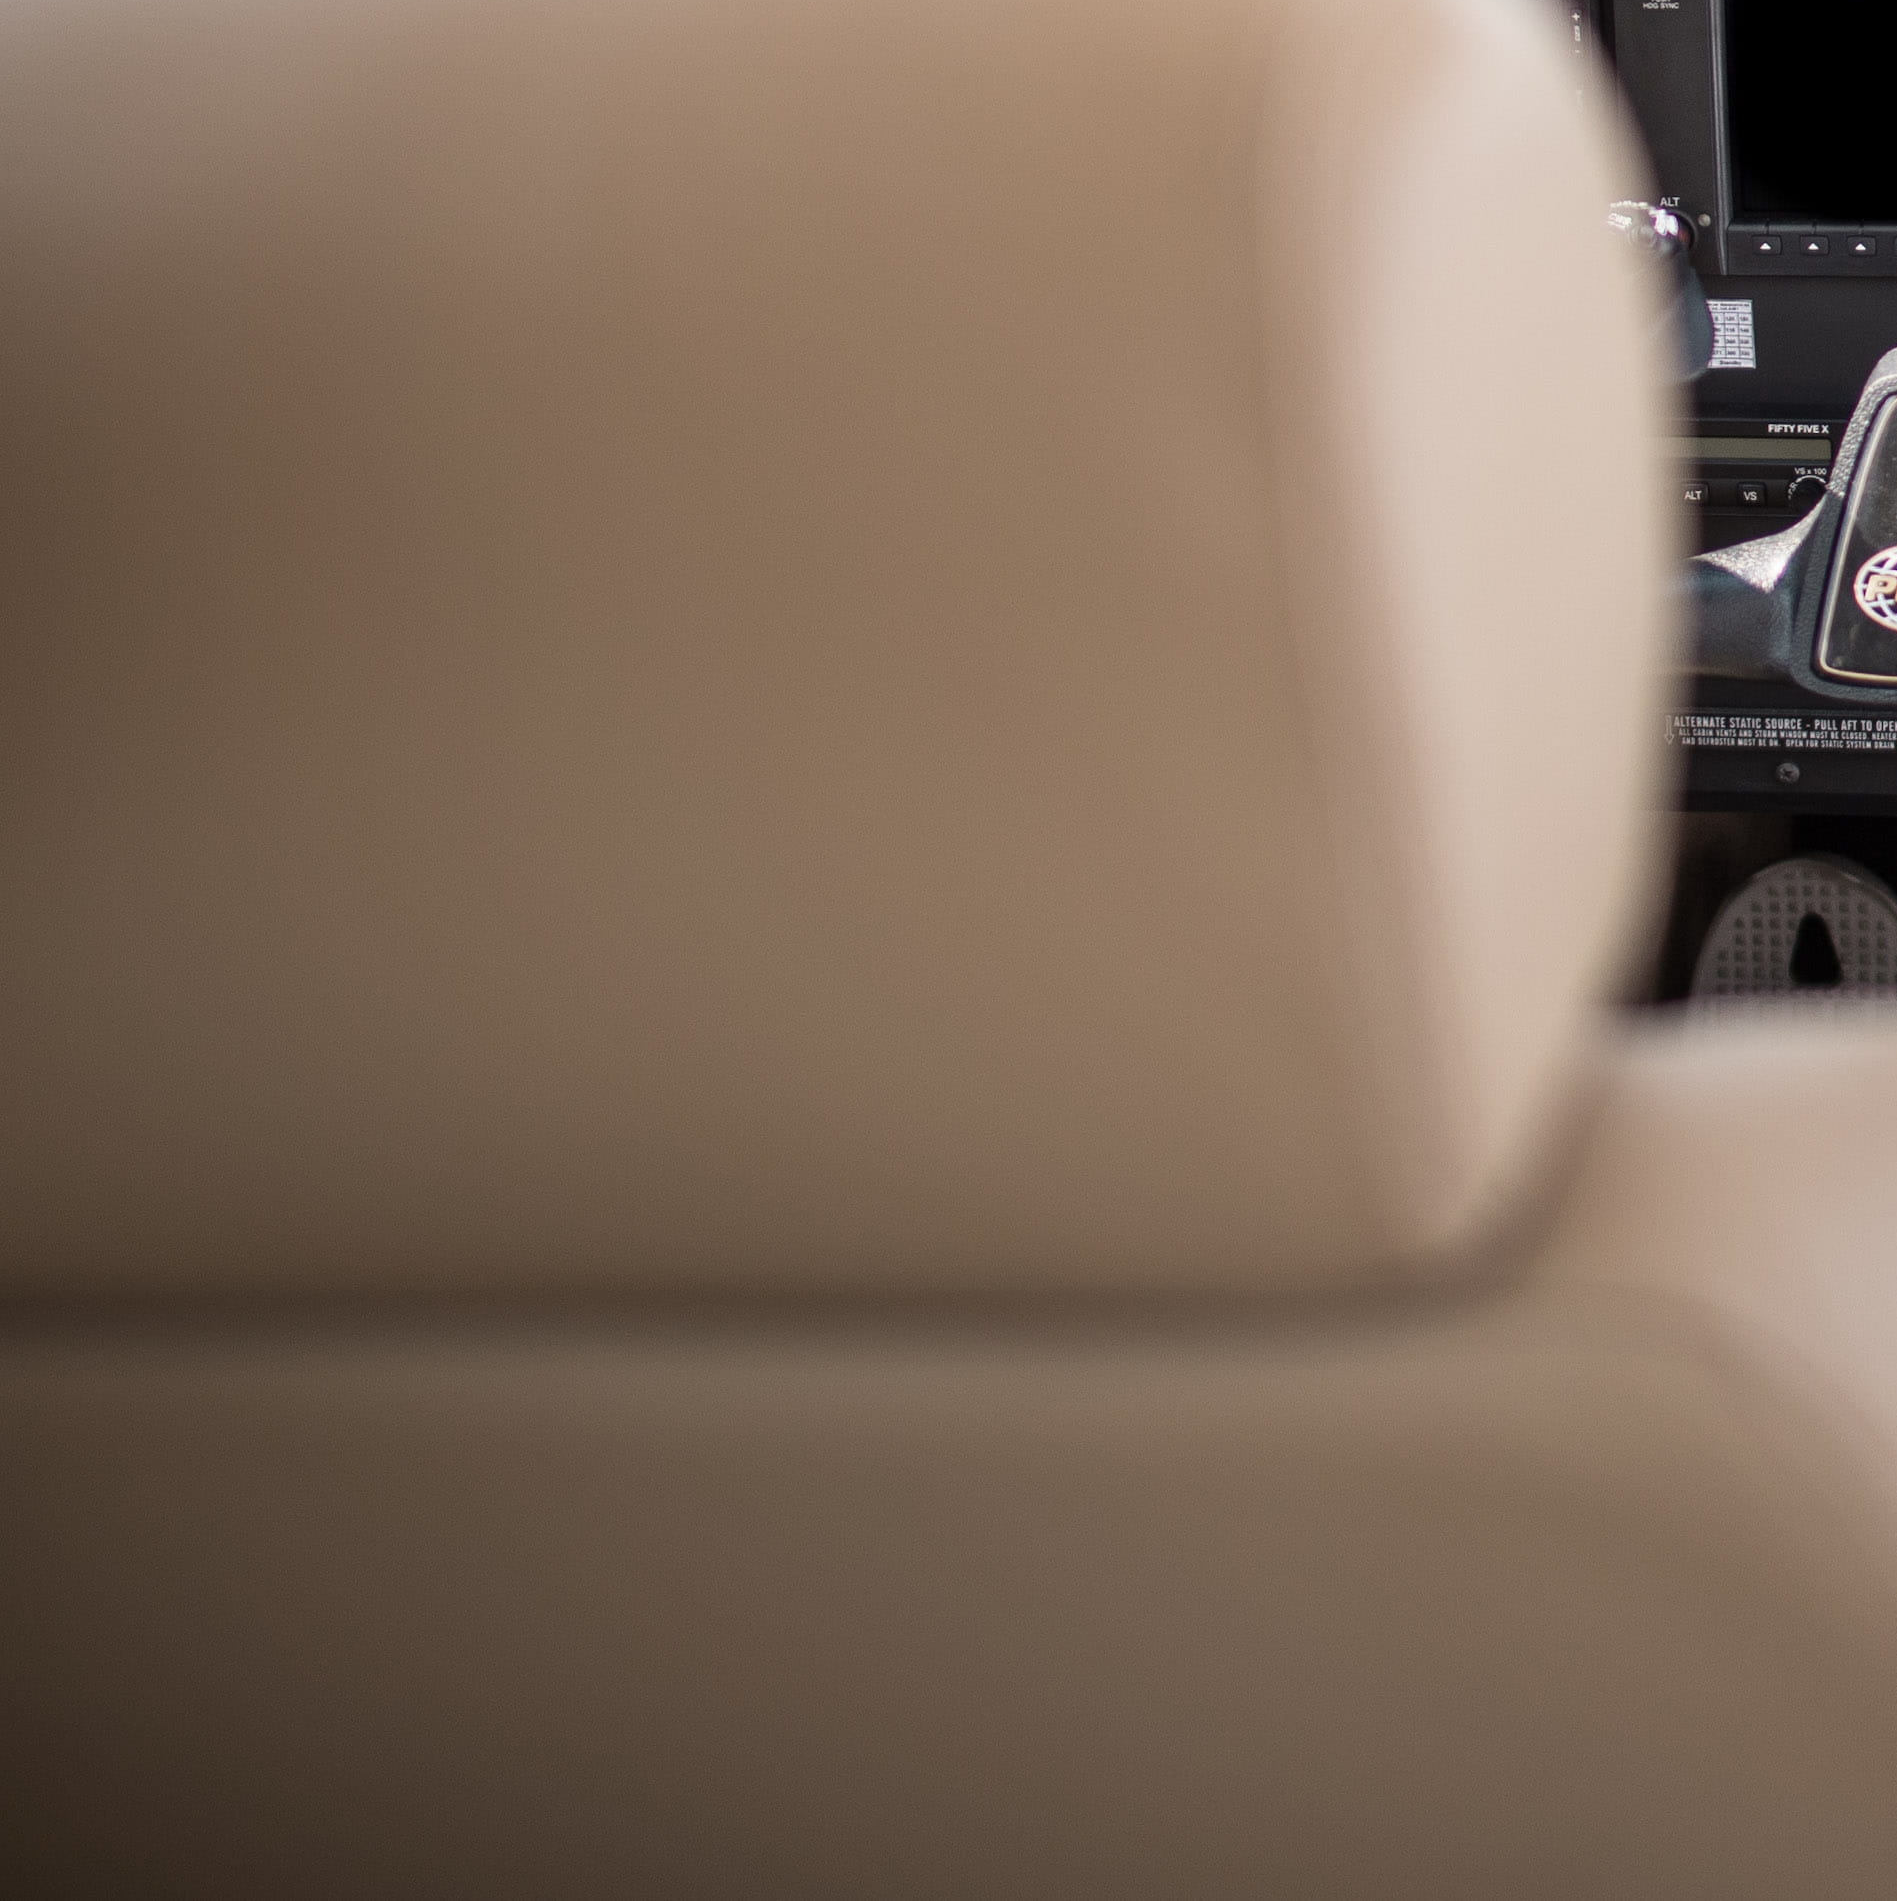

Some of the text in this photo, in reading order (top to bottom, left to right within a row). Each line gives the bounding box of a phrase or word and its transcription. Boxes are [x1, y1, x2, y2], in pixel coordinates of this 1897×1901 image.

[1660, 197, 1680, 207] ALT
[1767, 424, 1829, 434] FIFTY FIVE X
[1794, 467, 1827, 475] VS 100
[1685, 490, 1702, 500] ALT
[1744, 491, 1757, 501] VS
[1673, 716, 1726, 728] ALTERNATE
[1730, 717, 1762, 729] STATIC
[1765, 718, 1802, 730] SOURCE
[1814, 719, 1838, 731] PULL
[1841, 720, 1857, 731] AFT
[1860, 720, 1872, 731] TO
